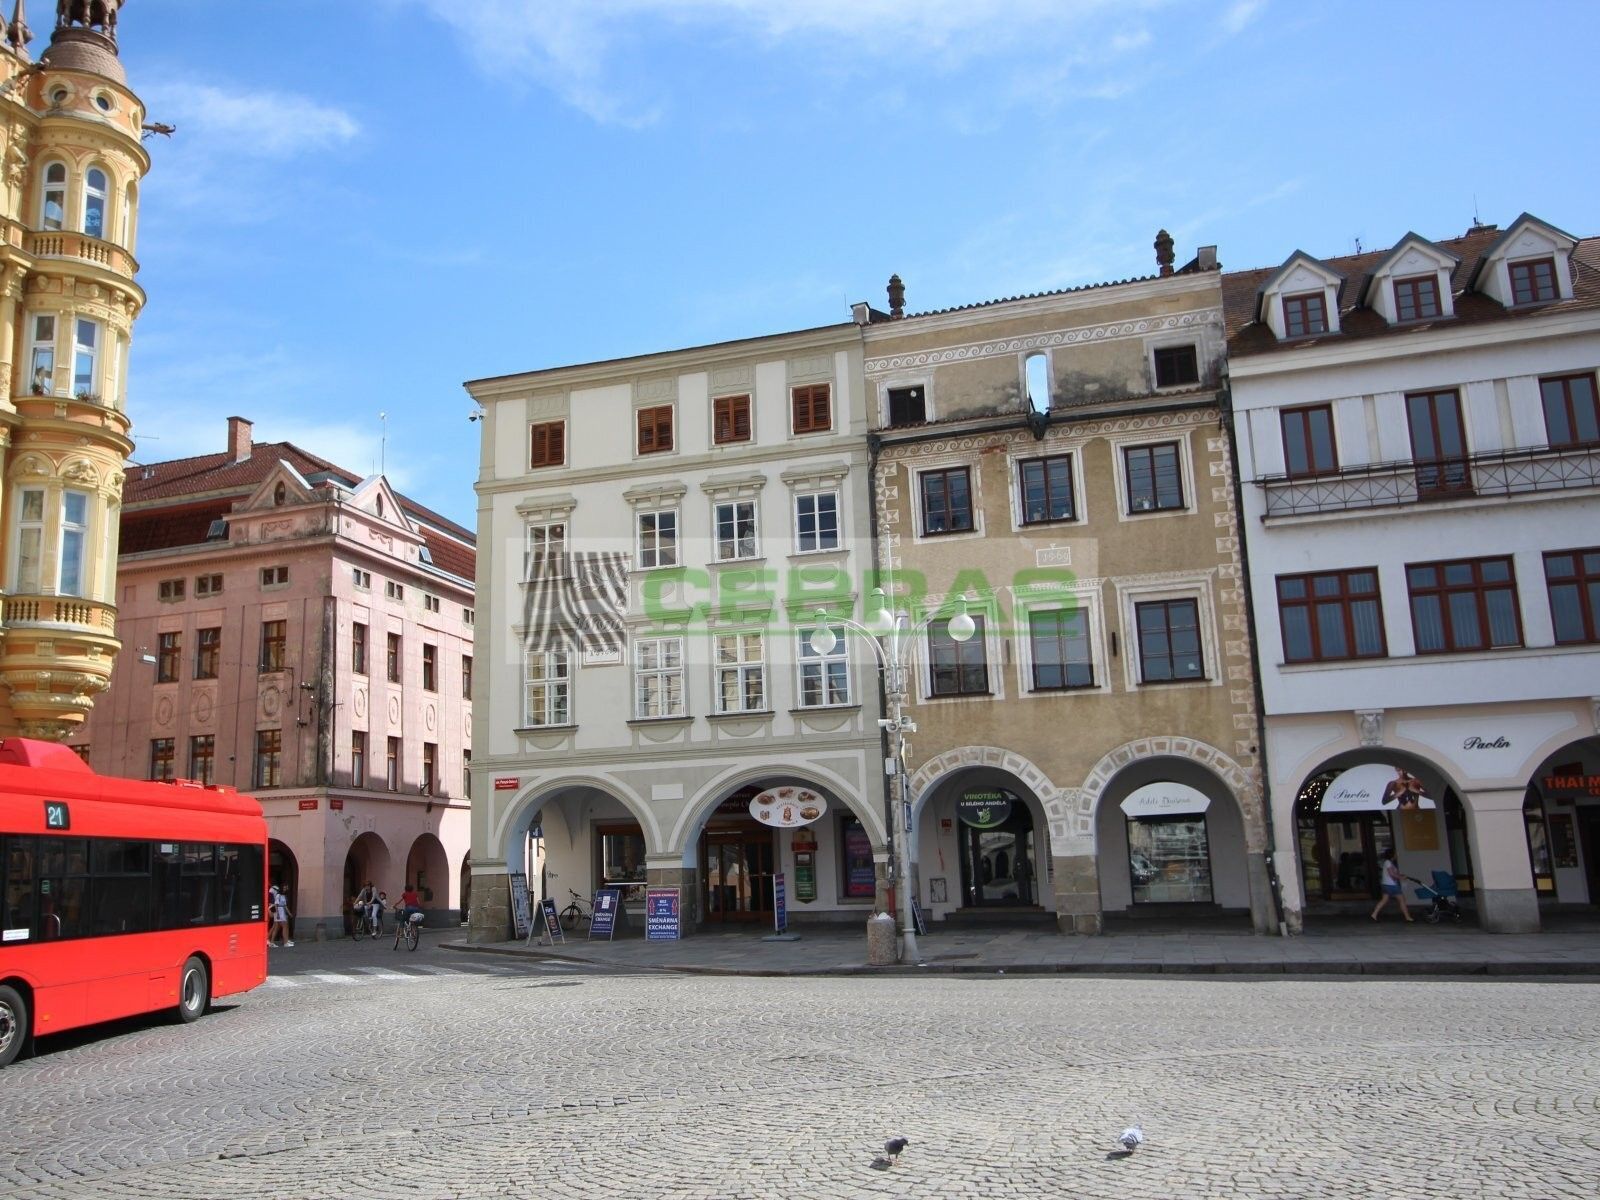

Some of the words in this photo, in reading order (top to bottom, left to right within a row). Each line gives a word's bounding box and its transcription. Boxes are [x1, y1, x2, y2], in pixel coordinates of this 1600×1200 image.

[1463, 736, 1511, 750] Paolin
[1545, 776, 1584, 789] THAI
[48, 806, 62, 826] 21
